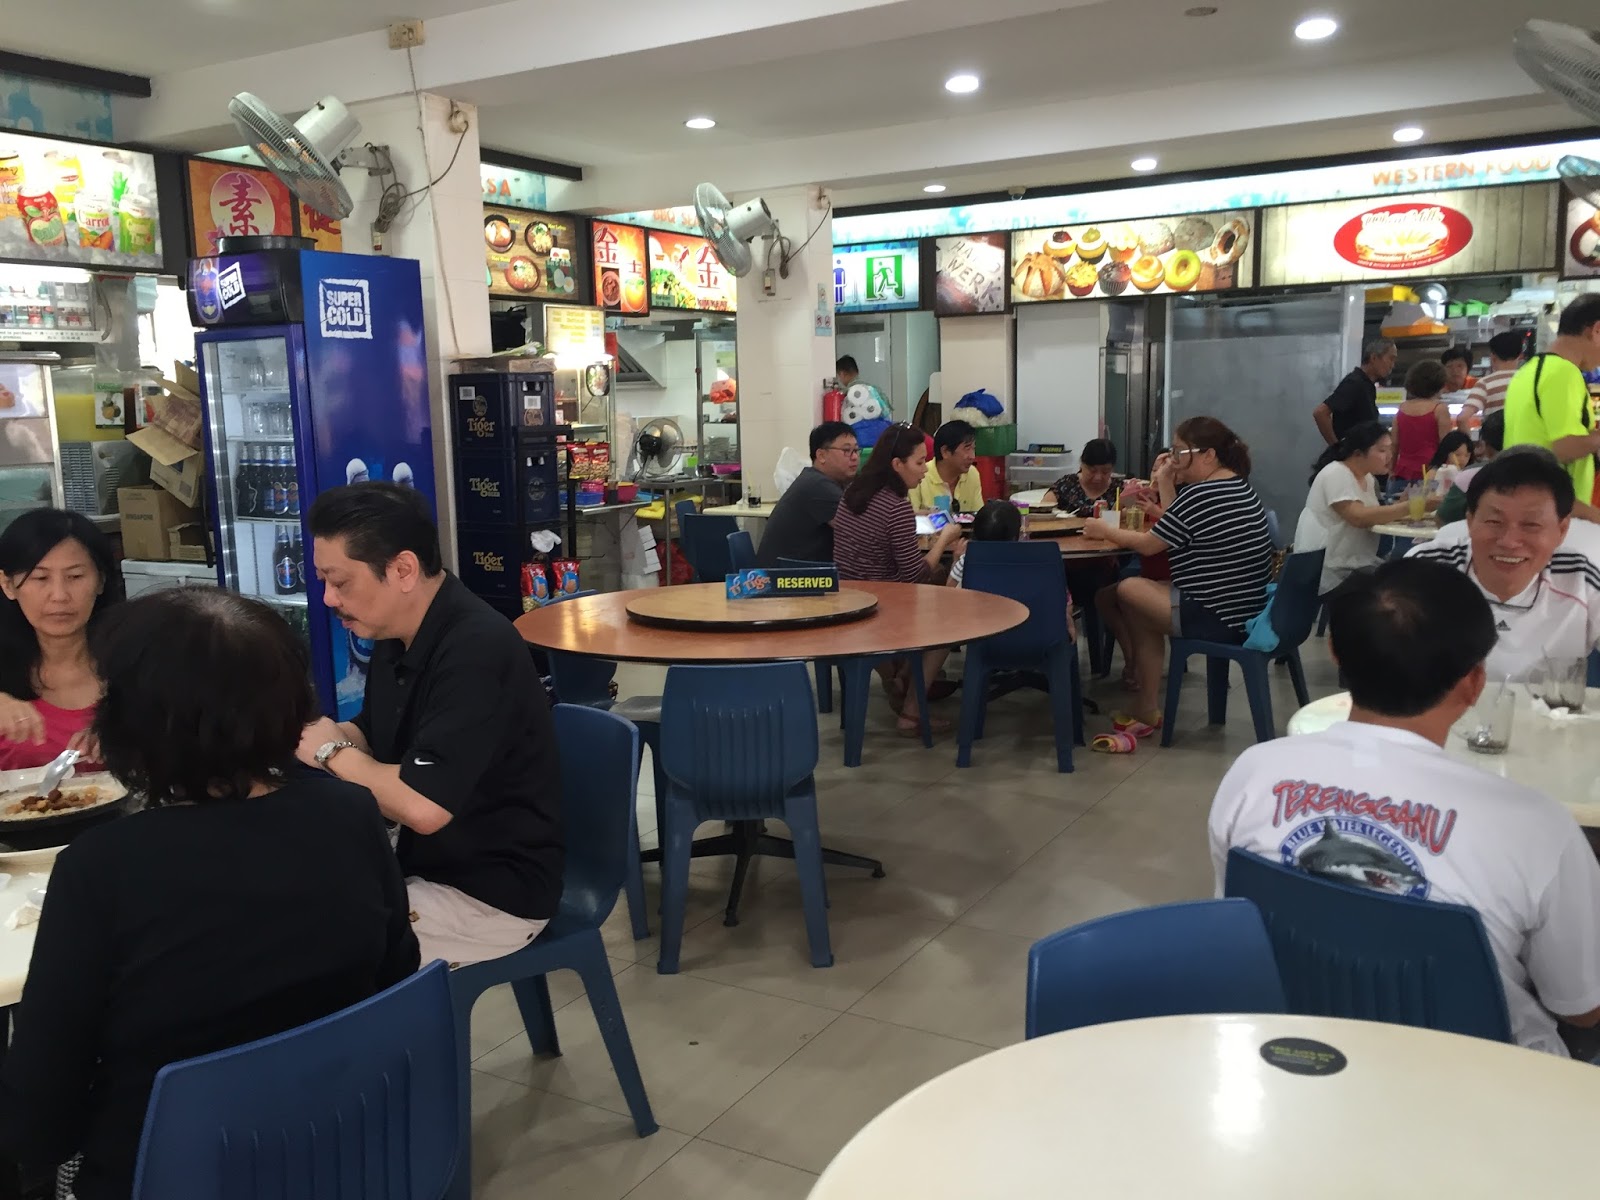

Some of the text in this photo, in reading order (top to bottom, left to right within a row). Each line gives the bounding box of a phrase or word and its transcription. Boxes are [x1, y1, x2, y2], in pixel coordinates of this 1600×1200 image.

[1372, 156, 1551, 187] WESTERN FOOD
[481, 177, 511, 197] SA
[219, 172, 262, 235] 素
[326, 289, 362, 307] SUPER
[326, 306, 364, 327] COLD
[466, 417, 495, 438] Tiger
[469, 478, 500, 497] Tiger
[473, 551, 504, 571] Tiger
[742, 575, 771, 590] Tiger
[777, 577, 833, 589] RESERVED
[1272, 779, 1457, 856] TERENGGANU
[1285, 822, 1316, 850] BLUE
[1365, 823, 1420, 872] LEGENDS
